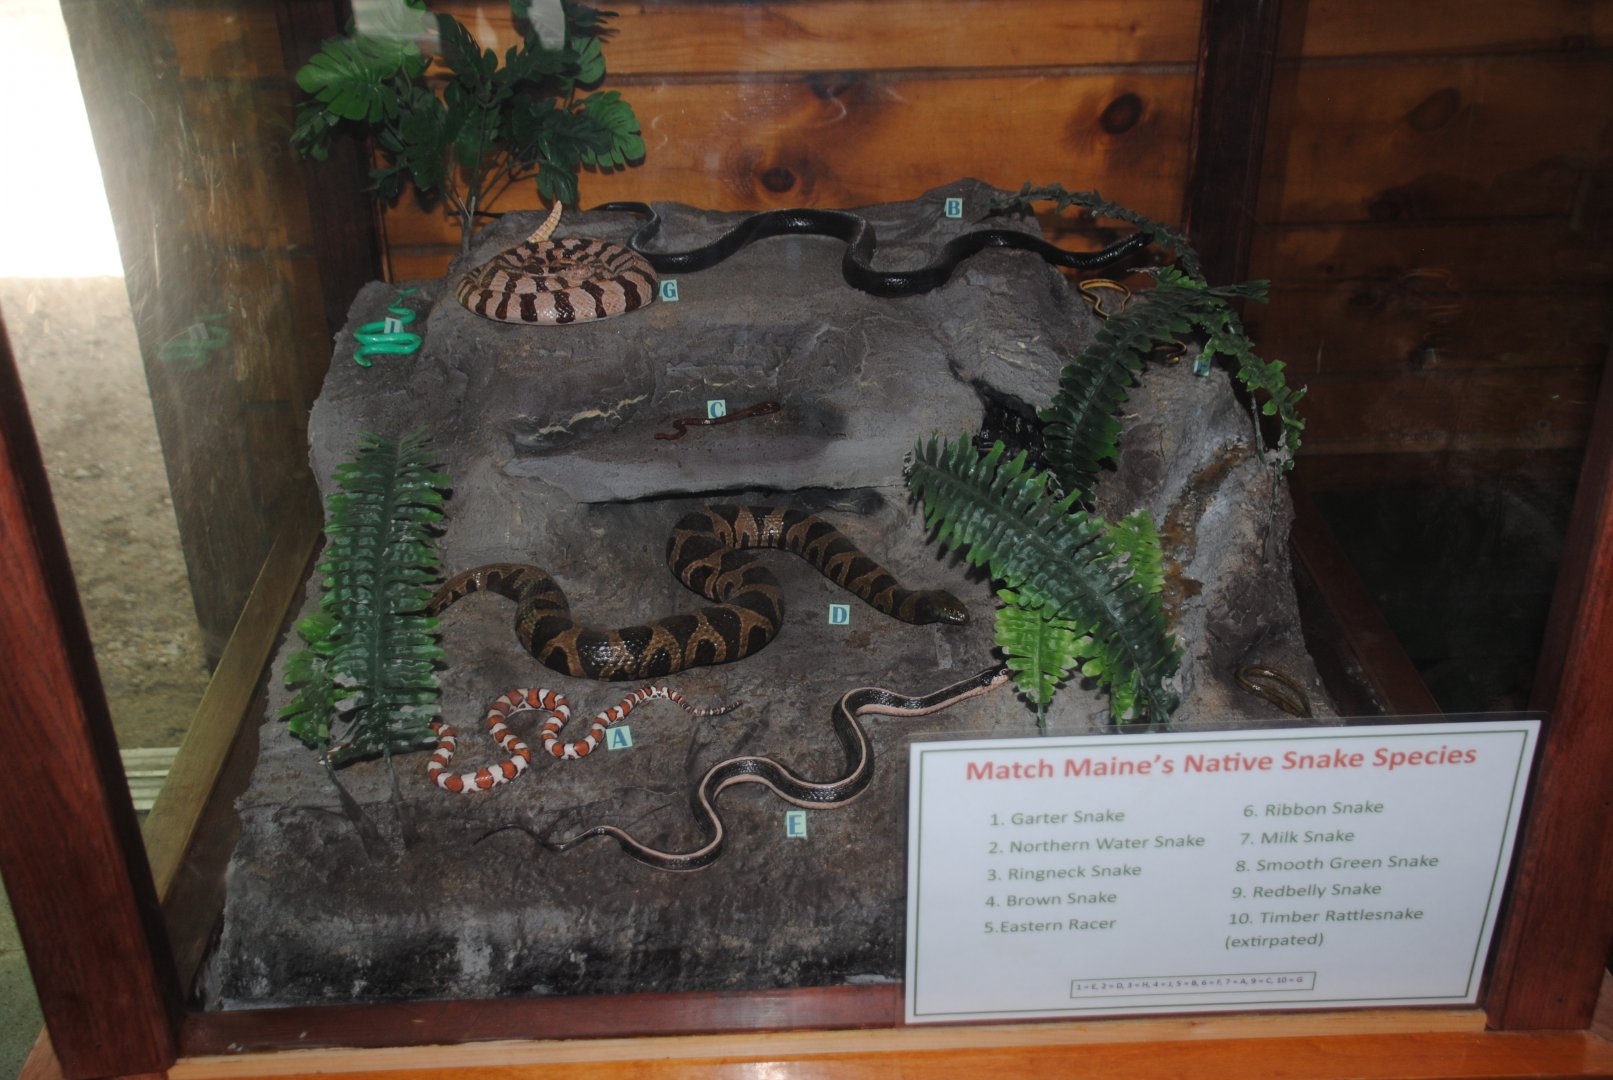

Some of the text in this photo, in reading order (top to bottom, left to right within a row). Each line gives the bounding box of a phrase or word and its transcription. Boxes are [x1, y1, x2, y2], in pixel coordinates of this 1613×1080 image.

[948, 200, 960, 216] B
[662, 282, 676, 298] G
[710, 402, 724, 418] C
[832, 606, 848, 624] D
[612, 727, 628, 748] A
[967, 746, 1476, 780] Match Maine’s Native Snake Species
[1243, 801, 1383, 817] 6. Ribbon Snake
[788, 814, 804, 835] E
[990, 810, 1125, 826] 1. Garter Snake
[989, 835, 1205, 854] 2. Northern Water Snake
[1241, 830, 1354, 845] 7. Milk Snake
[1235, 855, 1438, 872] 8. Smooth Green Snake
[987, 864, 1141, 882] 3. Ringneck Snake
[1232, 883, 1381, 898] 9. Redbelly Snake
[985, 892, 1117, 907] 4. Brown Snake
[1069, 919, 1116, 930] Racer
[1230, 908, 1423, 925] 10. Timber Rattlesnake
[1225, 933, 1323, 950] (extirpated)
